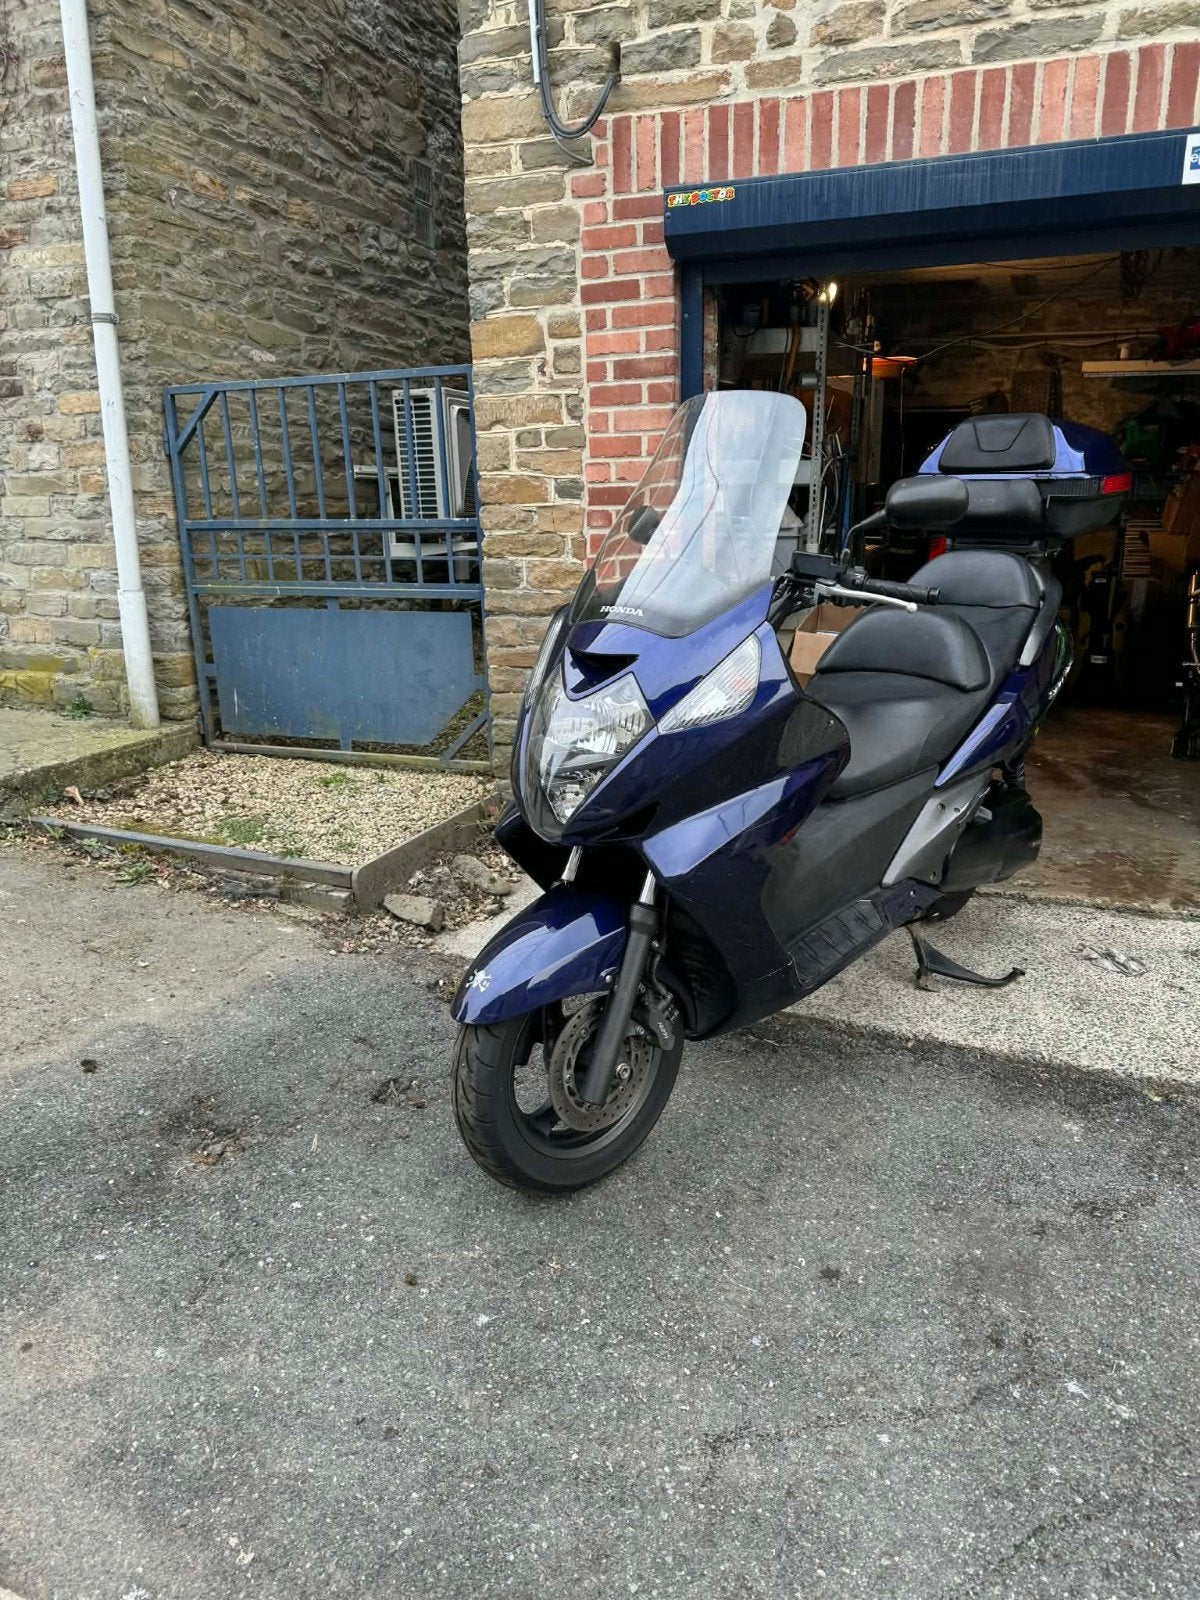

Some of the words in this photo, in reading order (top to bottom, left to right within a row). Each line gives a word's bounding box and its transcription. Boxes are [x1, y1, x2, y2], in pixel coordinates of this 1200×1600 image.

[668, 193, 690, 207] THE
[690, 187, 735, 205] DOCTOR
[599, 605, 644, 617] HONDA
